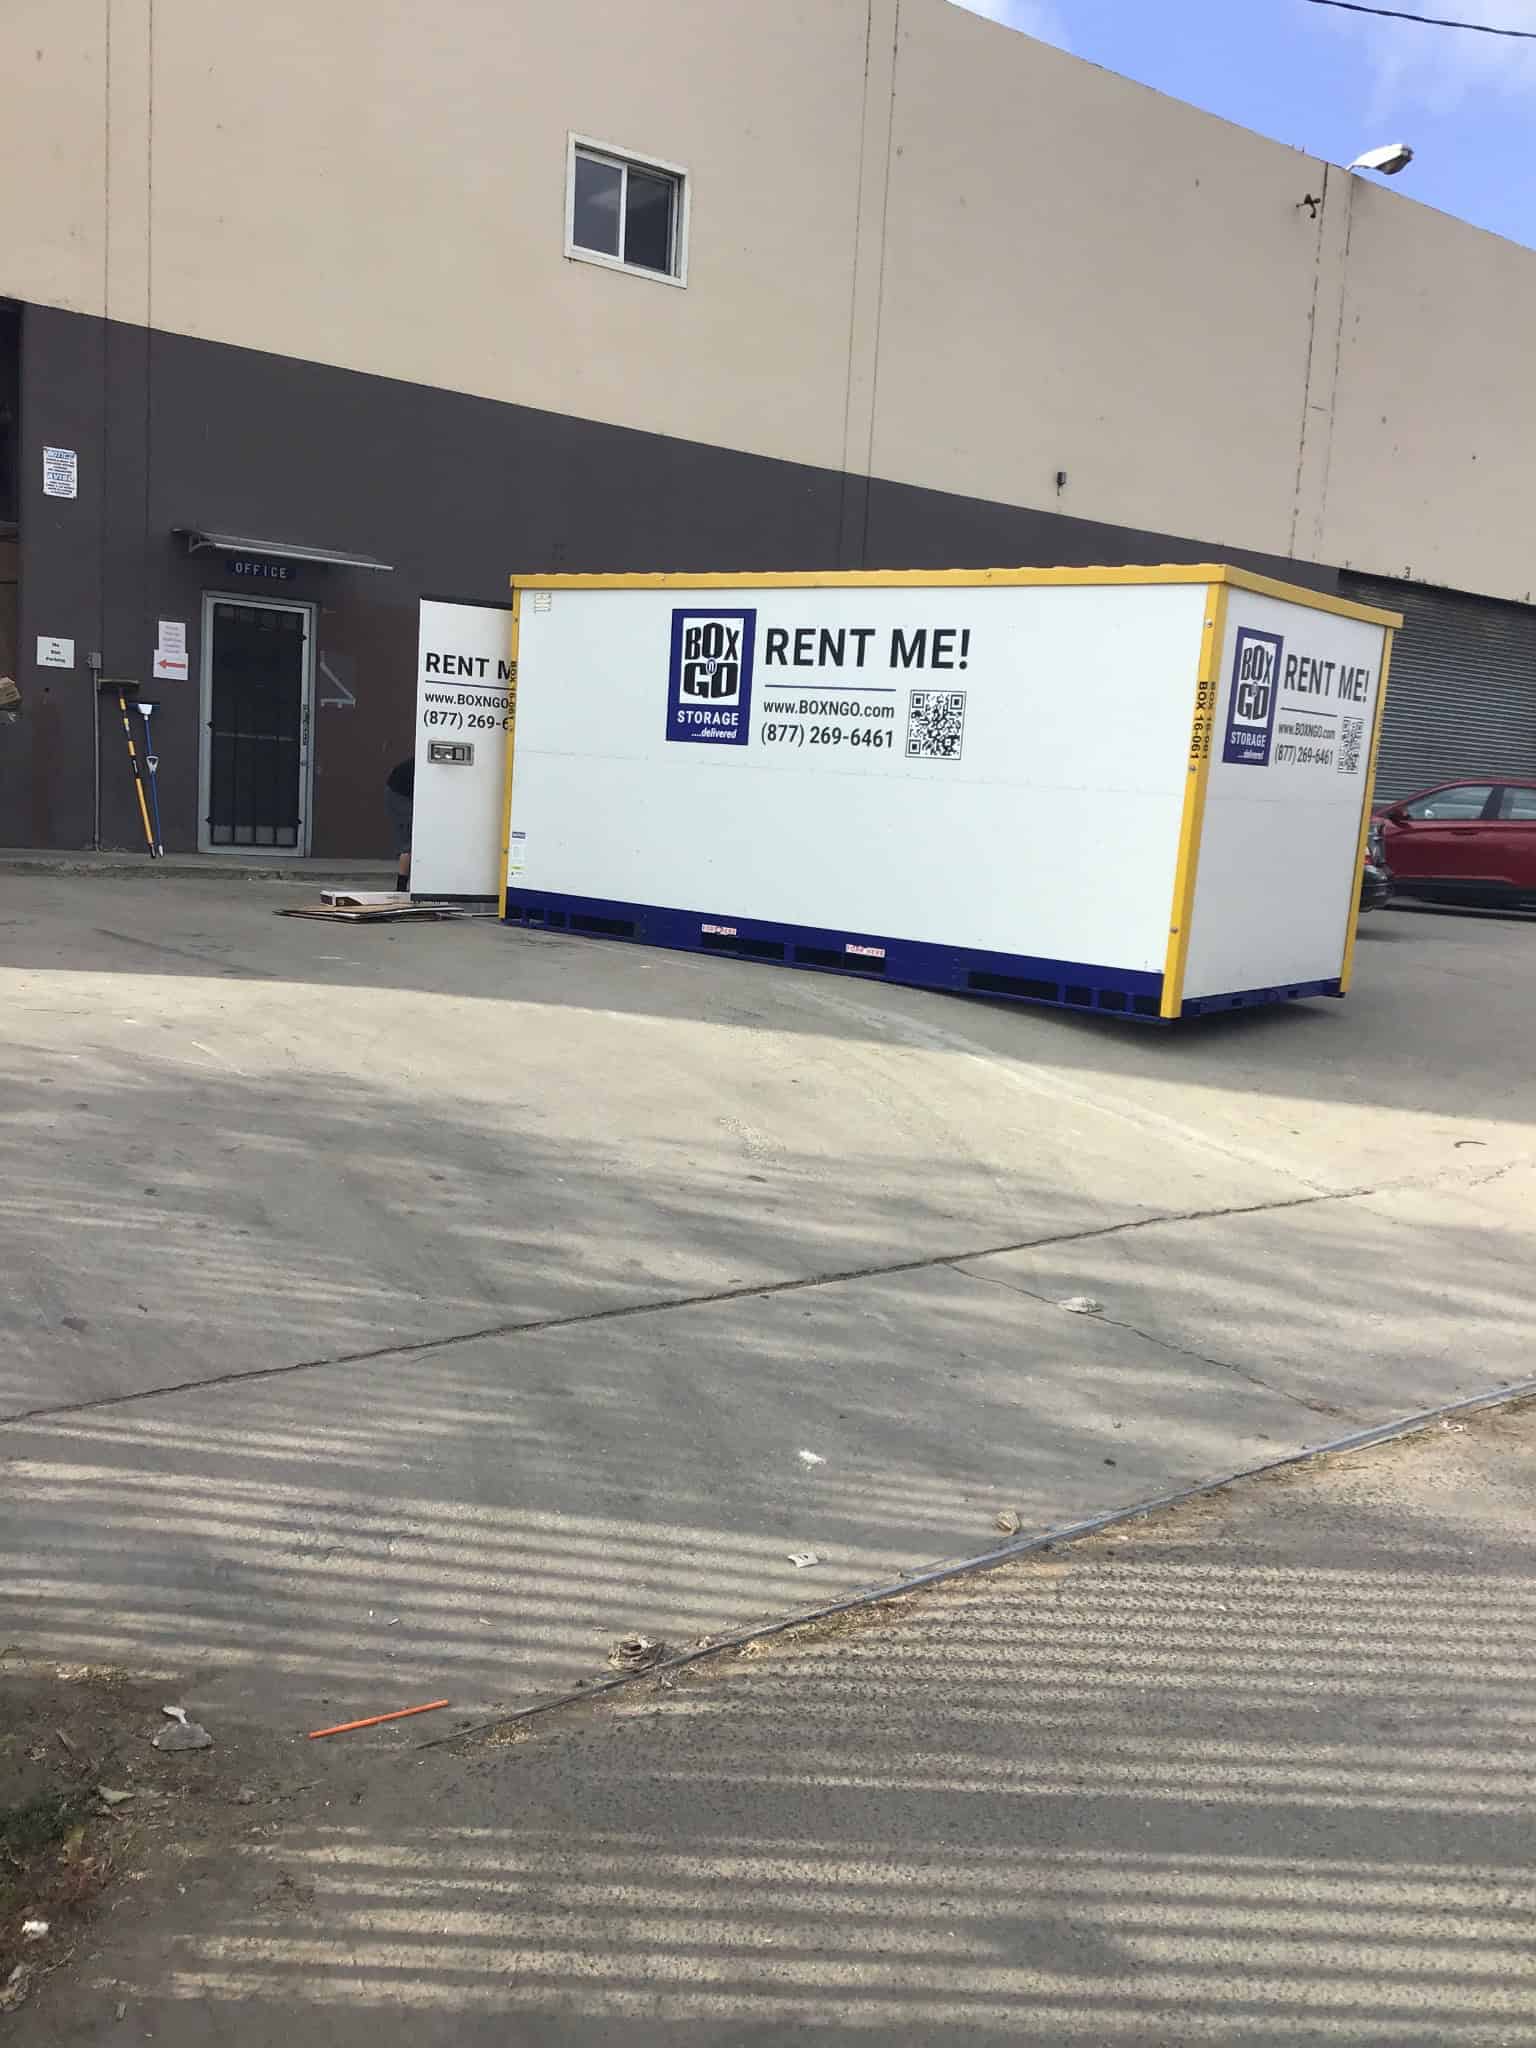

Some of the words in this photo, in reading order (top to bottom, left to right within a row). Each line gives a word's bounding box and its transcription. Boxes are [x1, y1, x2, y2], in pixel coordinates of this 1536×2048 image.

[235, 562, 287, 579] OFFICE
[685, 622, 740, 661] BOX
[764, 627, 876, 667] RENT
[889, 628, 971, 671] ME!
[425, 652, 490, 679] RENT
[1240, 645, 1274, 685] BOX
[1283, 654, 1336, 697] RENT
[1337, 665, 1370, 704] ME!
[683, 662, 739, 699] GO
[763, 699, 895, 719] www.BOXNGO.com
[1196, 681, 1209, 710] BOX
[1237, 683, 1270, 721] GO
[423, 709, 464, 731] (877)
[677, 709, 740, 726] STORAGE
[1278, 722, 1336, 740] www.BOXNGO.com
[761, 721, 805, 747] (877)
[808, 724, 894, 749] 269-6461
[1190, 715, 1204, 759] 16-061
[1231, 731, 1267, 748] STORAGE
[1275, 743, 1297, 766] (877)
[1297, 746, 1334, 766] 269-6461
